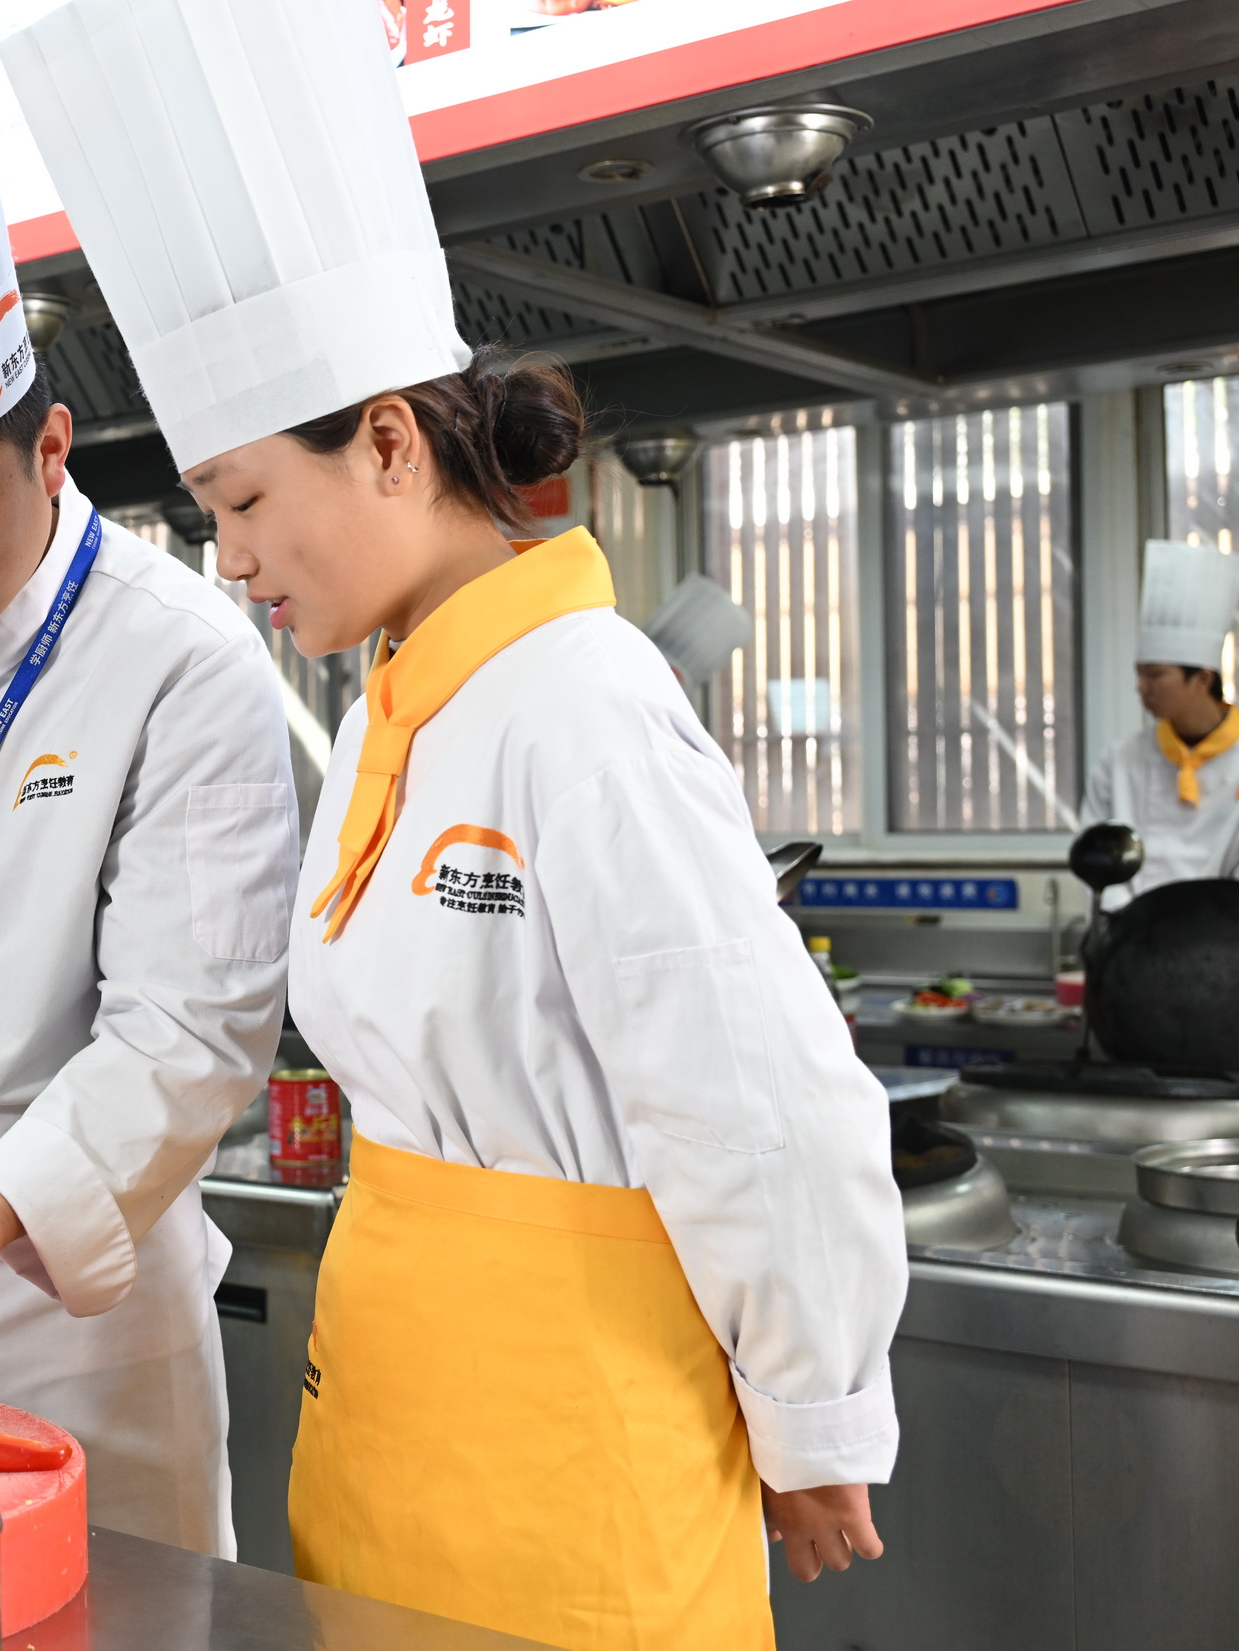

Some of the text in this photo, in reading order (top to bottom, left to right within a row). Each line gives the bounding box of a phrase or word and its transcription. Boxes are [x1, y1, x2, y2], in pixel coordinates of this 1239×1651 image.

[85, 532, 95, 547] NEW
[29, 580, 79, 666] 学厨师 新东方烹饪
[0, 698, 14, 718] EAST
[438, 864, 525, 895] 新东方烹饪教
